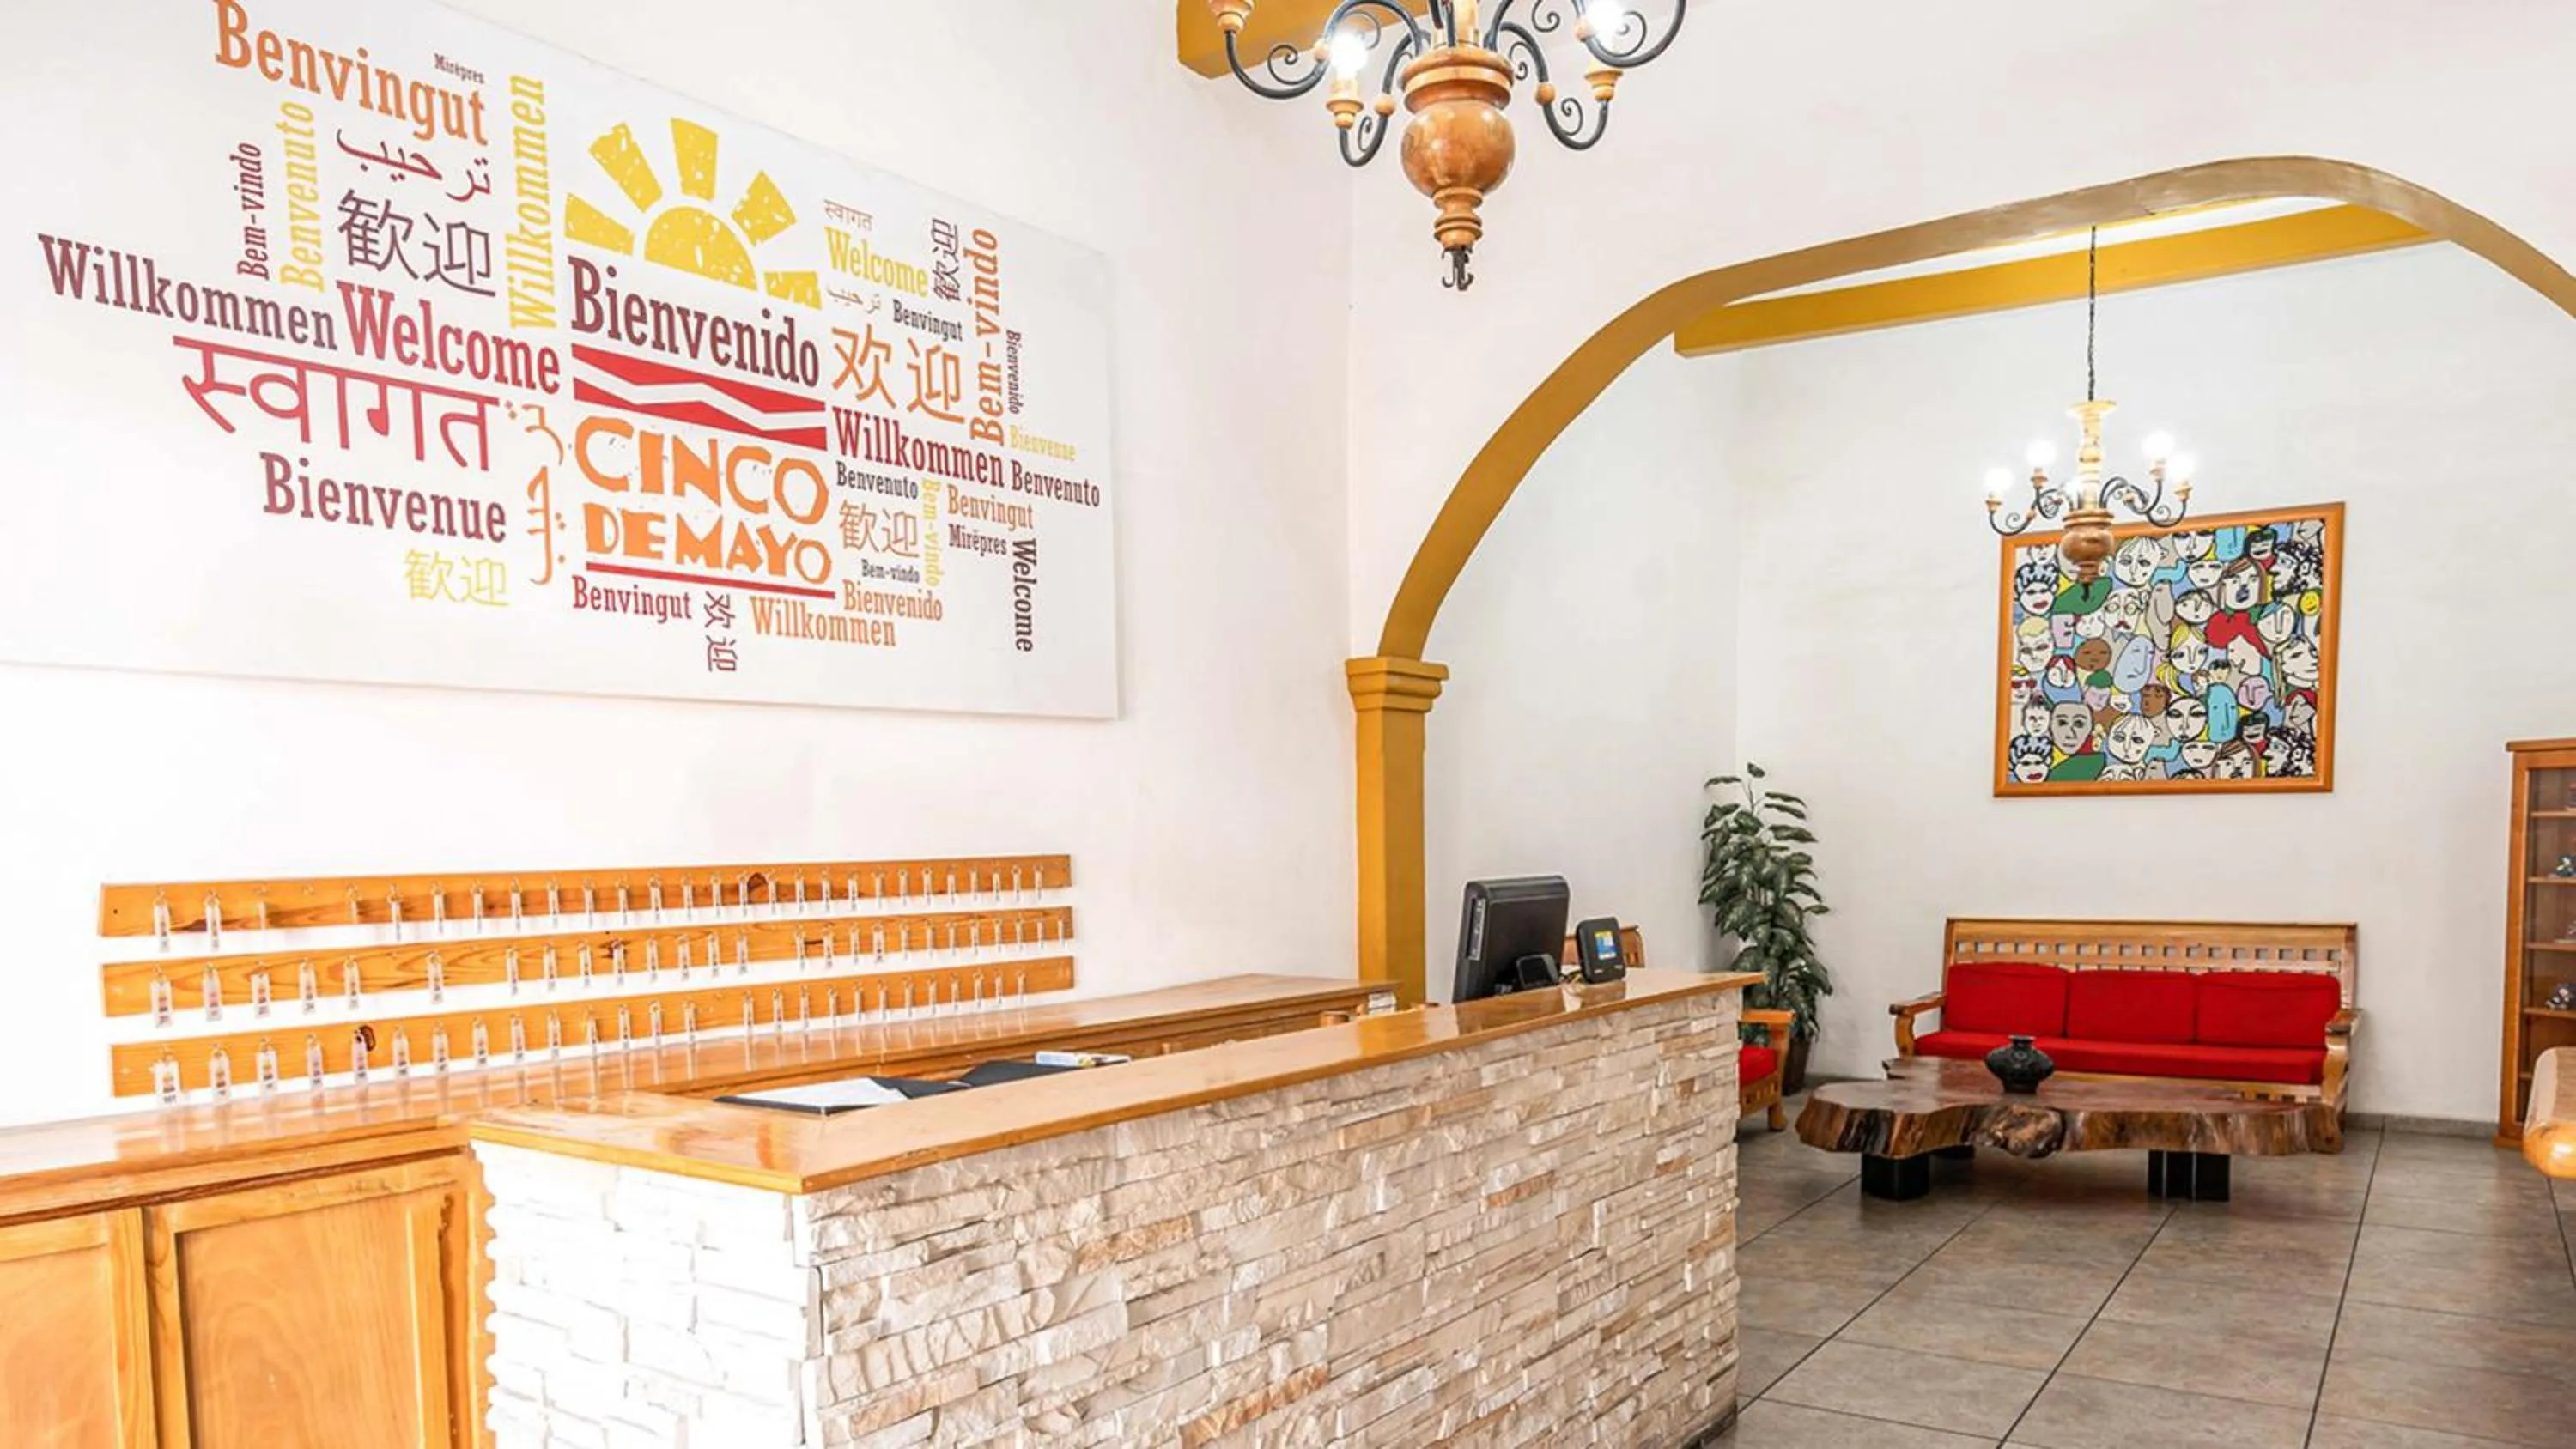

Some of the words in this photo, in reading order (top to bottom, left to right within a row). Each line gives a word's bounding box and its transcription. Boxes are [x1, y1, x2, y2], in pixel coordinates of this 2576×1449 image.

[214, 0, 489, 146] Benvingut
[275, 100, 325, 293] Benvenuto
[337, 128, 491, 202] ترحيب
[505, 74, 558, 330] Willkommen
[229, 143, 270, 281] Bem-vindo
[337, 188, 496, 297] 歓迎
[37, 233, 337, 351] Willkommen
[824, 226, 928, 298] Welcome
[336, 280, 561, 394] Welcome
[568, 255, 819, 388] Bienvenido
[893, 298, 963, 342] Benvingut
[963, 229, 1004, 446] Bem-vindo
[172, 335, 500, 471] स्वागत
[830, 322, 965, 425] 欢迎
[1006, 330, 1024, 415] Bienvenido
[505, 400, 567, 585] ترحيب
[574, 415, 830, 525] CINCO
[831, 406, 1005, 488] Willkommen
[835, 460, 919, 500] Benvenuto
[1011, 459, 1100, 508] Benvenuto
[259, 452, 507, 543] Bienvenue
[581, 501, 666, 561] DE
[671, 512, 832, 585] MAYO
[921, 477, 945, 587] Bem-vindo
[947, 483, 1033, 532] Benvingut
[948, 523, 1007, 557] Mirëpres
[571, 574, 693, 625] Benvingut
[842, 579, 943, 621] Bienvenido
[861, 558, 920, 584] Bem-vindo
[1012, 537, 1037, 652] Welcome
[703, 591, 738, 673] 欢迎
[748, 595, 897, 647] Willkommen
